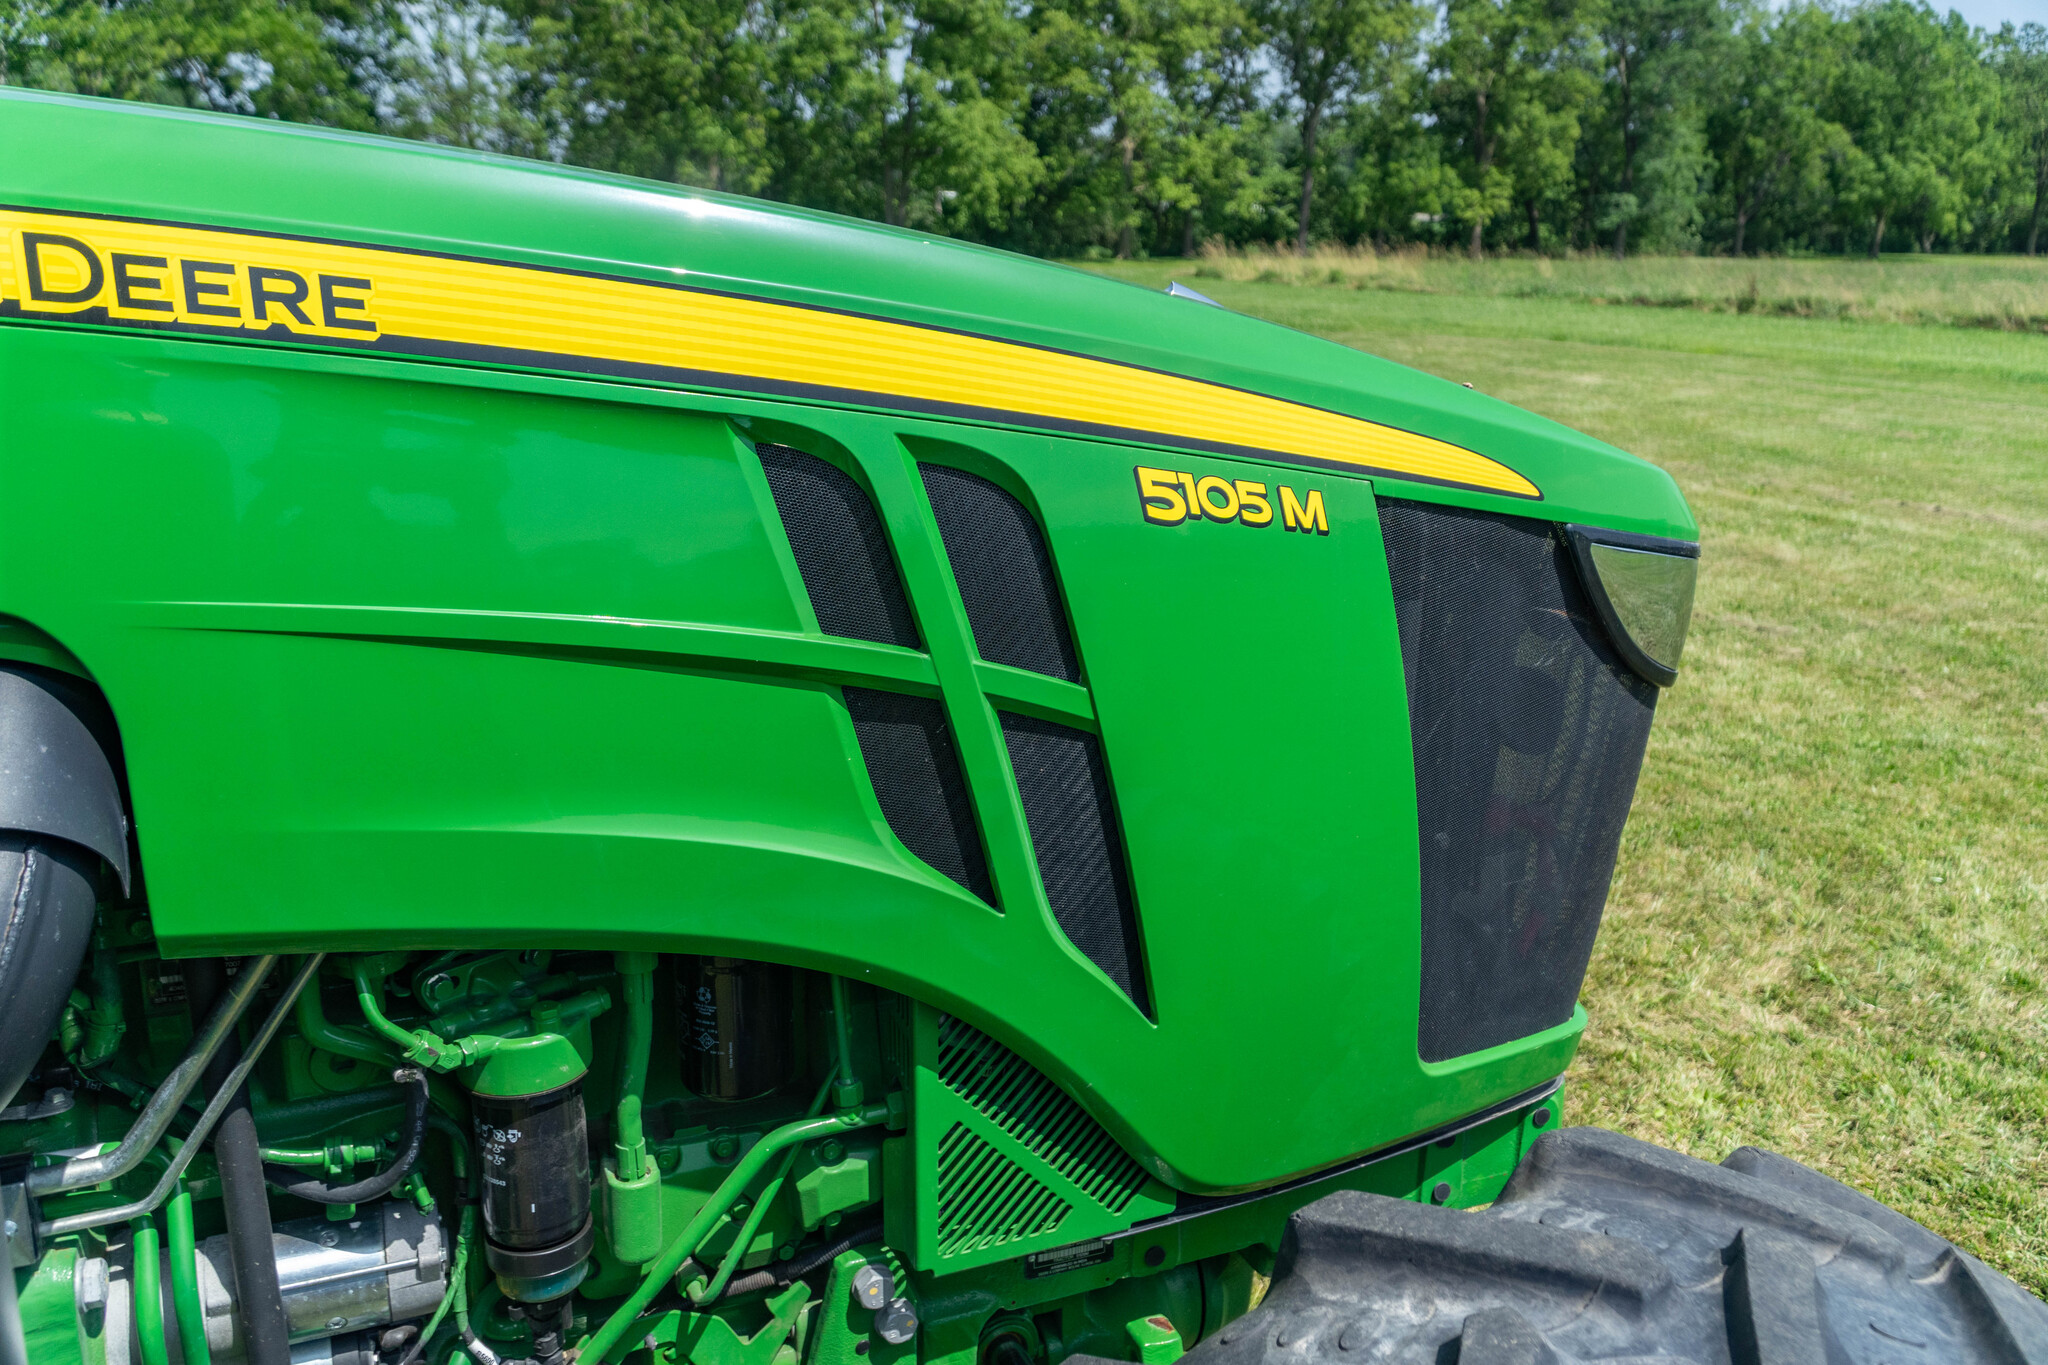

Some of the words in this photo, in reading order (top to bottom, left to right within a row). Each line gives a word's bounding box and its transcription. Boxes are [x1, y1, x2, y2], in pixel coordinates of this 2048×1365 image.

[20, 230, 379, 336] DEERE
[1133, 465, 1274, 528] 5105
[1276, 484, 1330, 537] M
